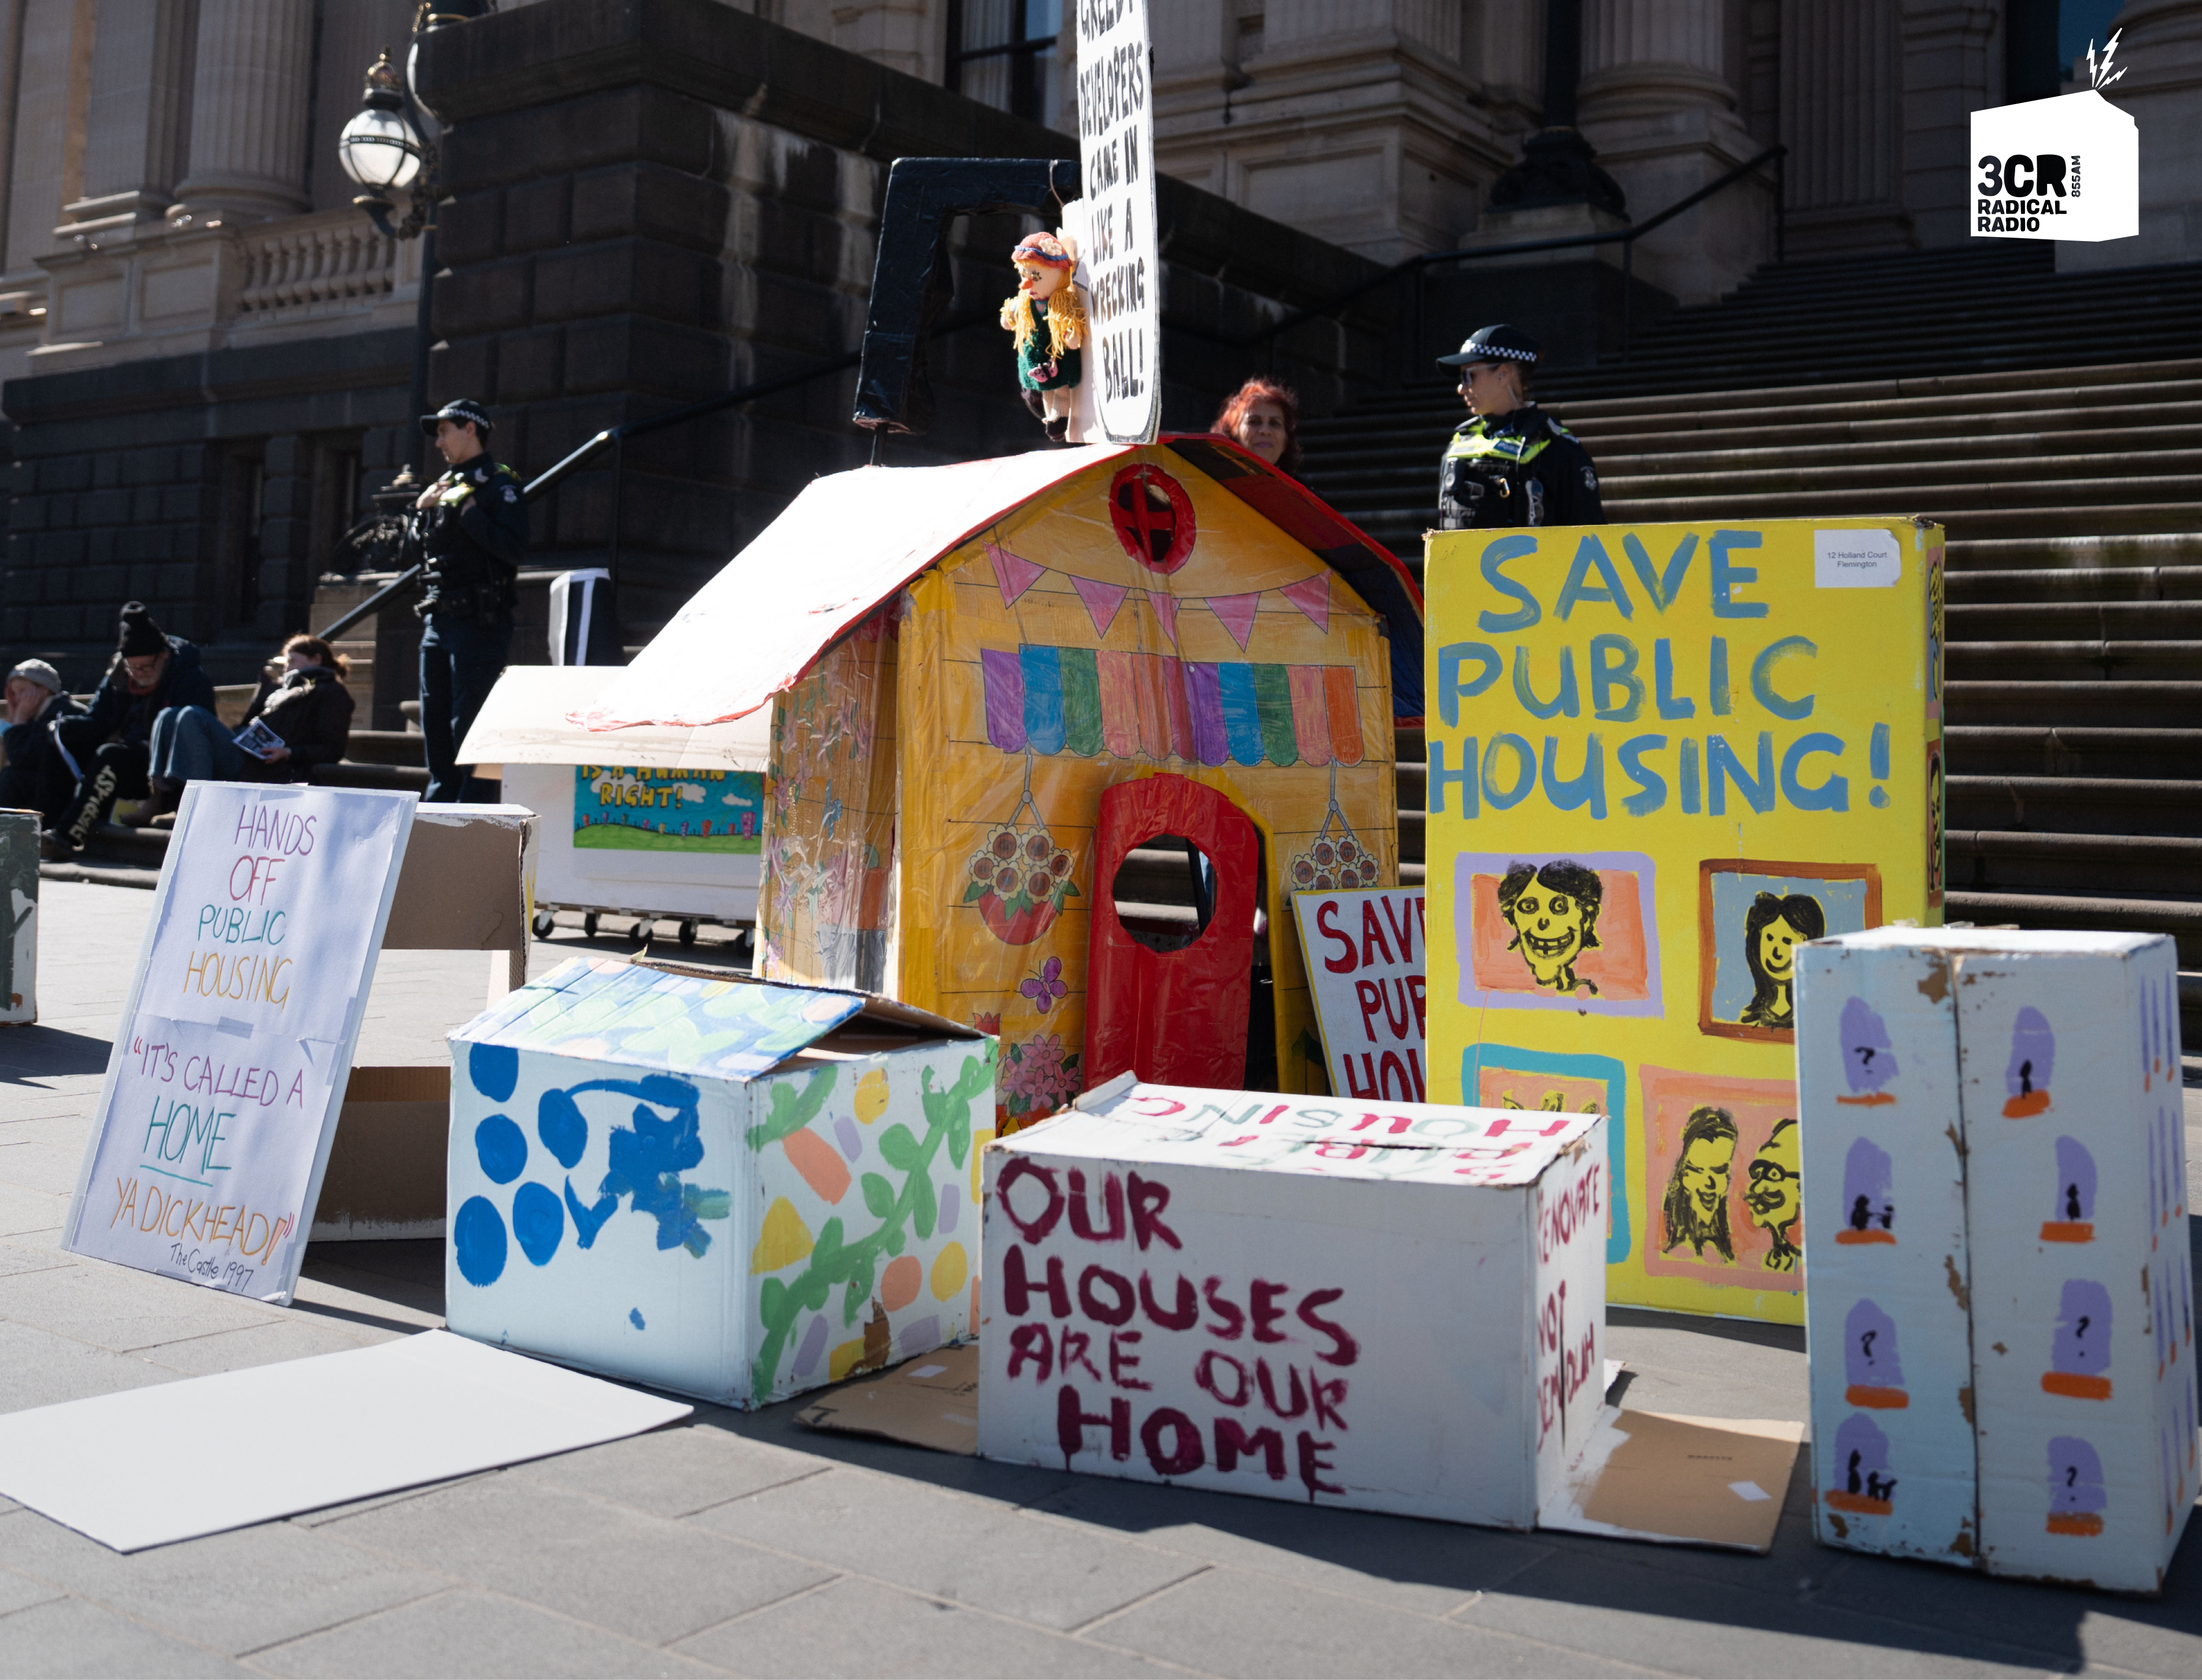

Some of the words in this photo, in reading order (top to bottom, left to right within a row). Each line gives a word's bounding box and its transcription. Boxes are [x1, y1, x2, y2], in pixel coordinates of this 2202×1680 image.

[1081, 0, 1133, 43] GRE
[1080, 40, 1144, 140] DEVELOPERS
[1090, 138, 1119, 201] CAME
[1124, 124, 1139, 186] IN
[1092, 202, 1114, 267] LIKE
[1125, 197, 1133, 253] A
[1091, 256, 1144, 325] WRECKING
[1103, 328, 1144, 404] BALL!
[1476, 530, 1770, 634] SAVE
[1438, 634, 1818, 729] PUBLIC
[581, 765, 603, 780] IS
[600, 783, 683, 809] RIGHT!
[1427, 723, 1891, 820] HOUSING!
[234, 804, 317, 856] HANDS
[230, 854, 286, 906] OFF
[198, 904, 286, 946] PUBLIC
[183, 951, 293, 1013] HOUSING
[184, 1055, 278, 1107] CALLED
[286, 1068, 304, 1109] A
[1131, 1095, 1571, 1138] HOUSING
[143, 1096, 237, 1176] HOME
[1223, 1153, 1514, 1179] SAE
[110, 1177, 138, 1230] YA
[997, 1156, 1183, 1252] OUR
[171, 1243, 188, 1267] The
[188, 1249, 219, 1281] Castle
[223, 1261, 255, 1292] 1997
[1003, 1244, 1362, 1366] HOUSES
[1007, 1322, 1153, 1392] ARE
[1195, 1349, 1350, 1433] OUR
[1056, 1384, 1347, 1504] HOME
